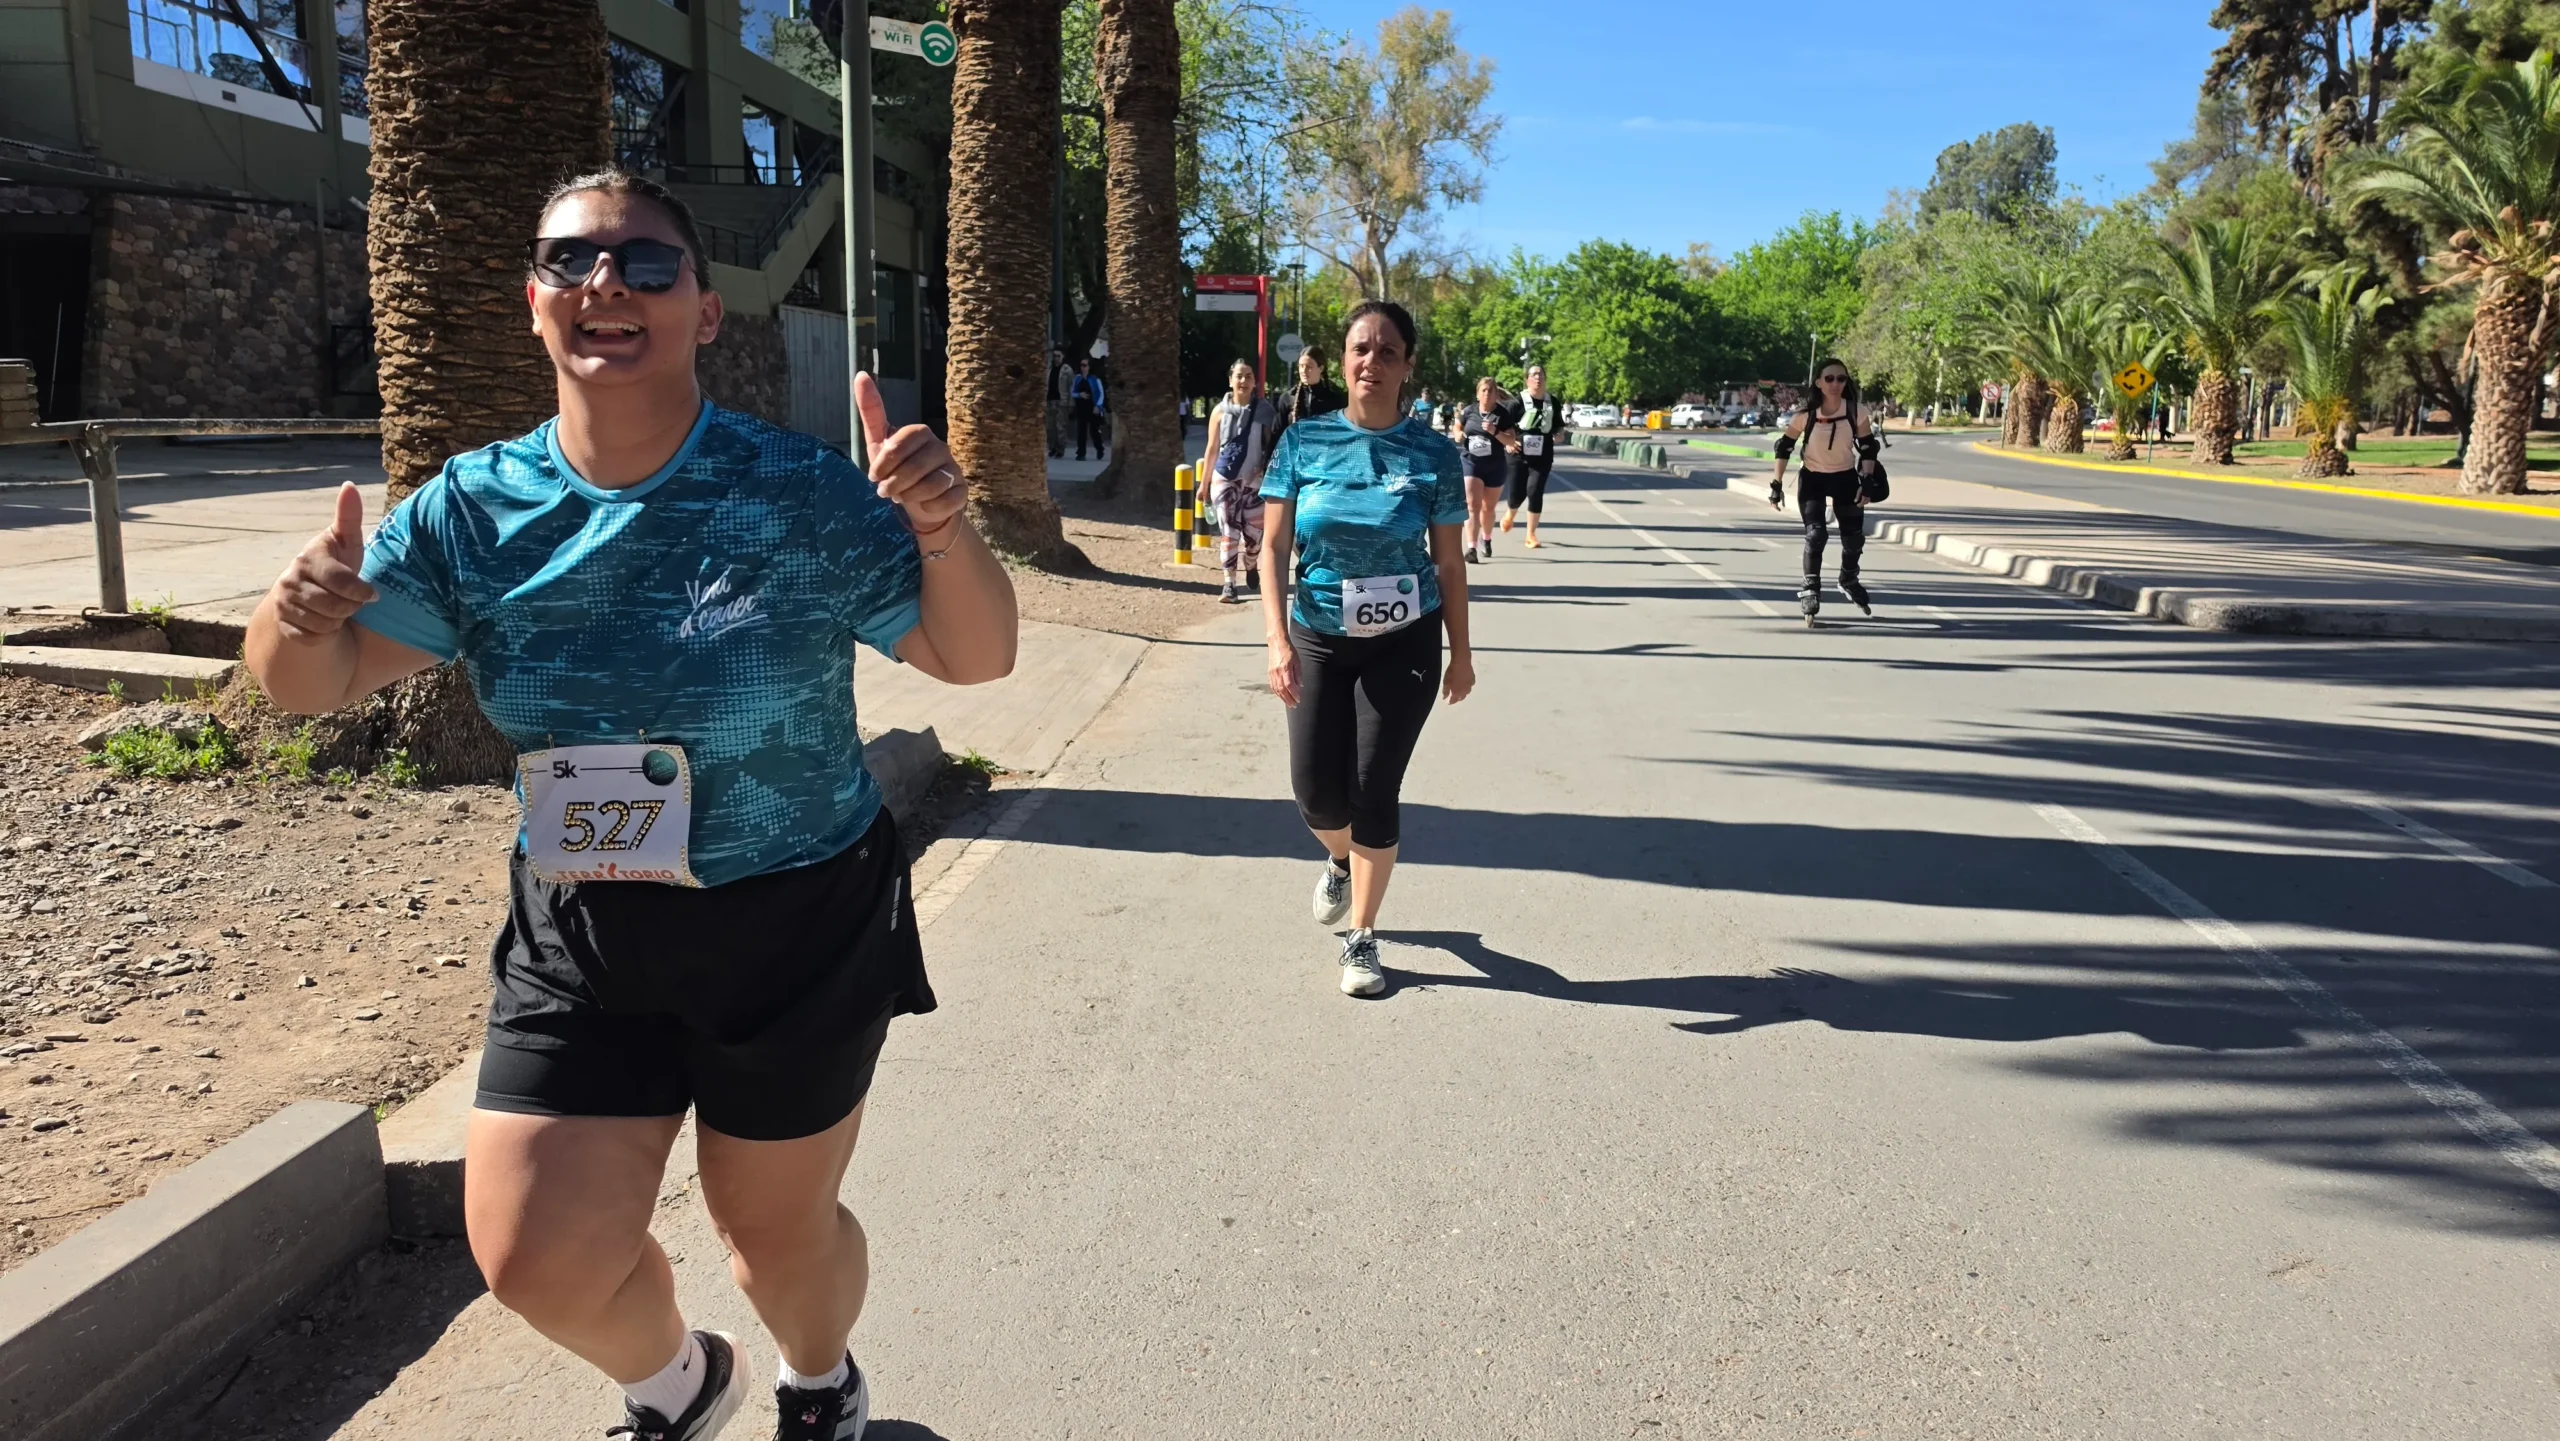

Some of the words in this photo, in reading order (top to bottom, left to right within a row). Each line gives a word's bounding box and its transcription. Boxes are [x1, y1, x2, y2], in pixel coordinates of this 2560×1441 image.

[884, 30, 900, 43] Wi
[903, 33, 912, 45] Fi
[1356, 600, 1409, 626] 650
[553, 759, 579, 779] 5k
[559, 799, 666, 852] 527
